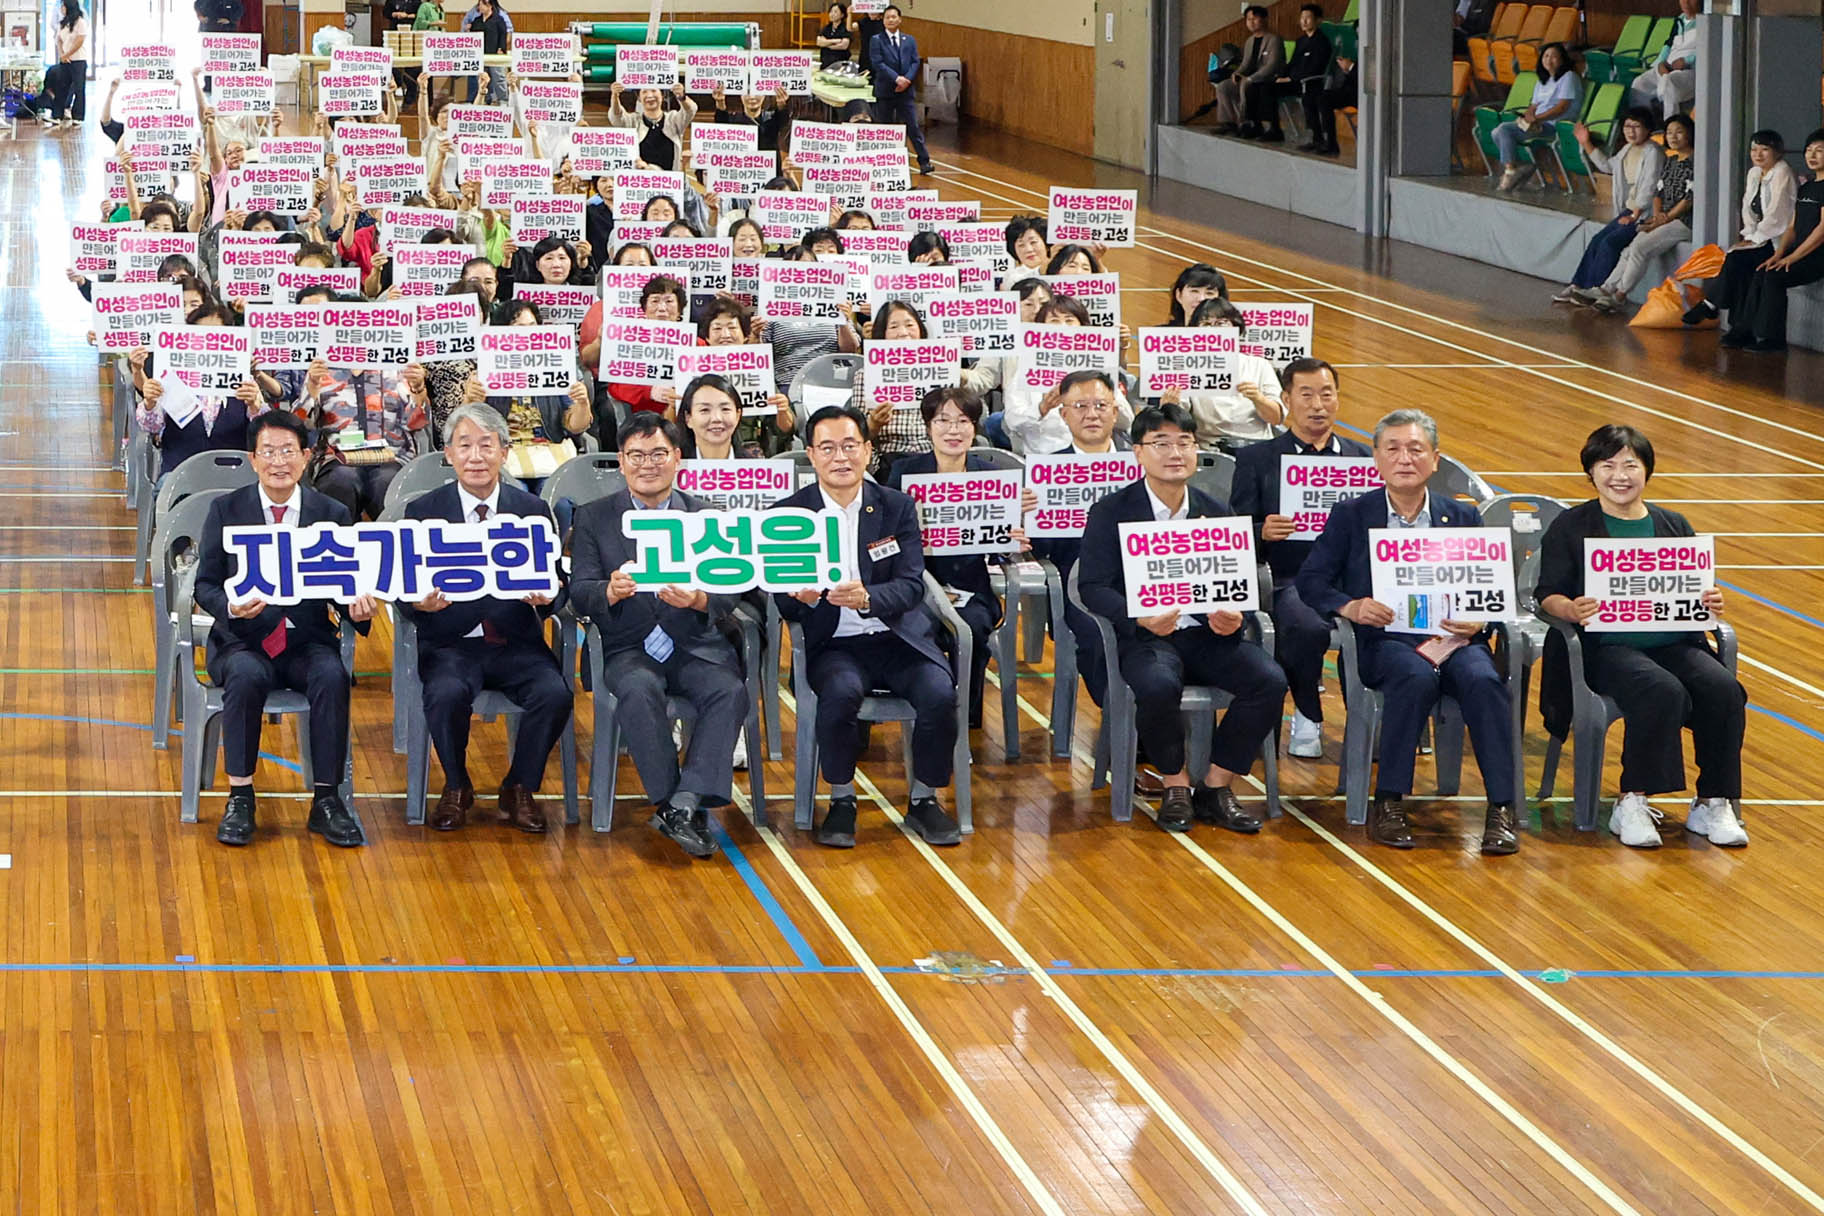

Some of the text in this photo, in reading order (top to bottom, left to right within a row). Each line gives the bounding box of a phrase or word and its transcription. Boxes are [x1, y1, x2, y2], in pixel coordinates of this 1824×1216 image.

[425, 36, 481, 48] 여성농업인이
[433, 49, 475, 59] 만들어가는
[618, 49, 676, 61] 여성농업인이
[427, 60, 479, 72] 성평등한 고성
[627, 62, 670, 71] 만들어가는
[620, 73, 674, 85] 성평등한 고성
[242, 168, 310, 182] 여성농업인이
[252, 184, 302, 195] 만들어가는
[245, 197, 307, 211] 성평등한 고성
[514, 199, 583, 213] 여성농업인이
[1052, 193, 1133, 211] 여성농업인이
[524, 215, 576, 226] 만들어가는
[1063, 211, 1123, 224] 만들어가는
[558, 228, 580, 242] 고성
[1054, 225, 1128, 242] 성평등한 고성
[763, 266, 844, 285] 여성농업인이
[774, 285, 835, 299] 만들어가는
[96, 292, 181, 313] 여성농업인이
[765, 300, 840, 318] 성평등한 고성
[109, 312, 173, 328] 만들어가는
[323, 309, 413, 327] 여성농업인이
[102, 330, 152, 348] 성평등한
[157, 331, 247, 352] 여성농업인이
[336, 329, 403, 343] 만들어가는
[481, 332, 571, 351] 여성농업인이
[1023, 330, 1114, 352] 여성농업인이
[1143, 334, 1235, 353] 여성농업인이
[170, 352, 237, 368] 만들어가는
[325, 345, 409, 364] 성평등한 고성
[495, 352, 562, 369] 만들어가는
[868, 345, 959, 365] 여성농업인이
[1036, 351, 1105, 367] 만들어가는
[1157, 355, 1225, 370] 만들어가는
[214, 372, 243, 390] 고성
[485, 370, 569, 390] 성평등한 고성
[882, 366, 949, 382] 만들어가는
[1148, 373, 1231, 391] 성평등한 고성
[873, 385, 925, 403] 성평등한
[675, 467, 788, 491] 여성농업인이
[1031, 460, 1141, 485] 여성농업인이
[906, 479, 1017, 504] 여성농업인이
[923, 503, 1005, 524] 만들어가는
[977, 524, 1012, 544] 고성
[1126, 527, 1249, 556] 여성농업인이
[631, 516, 840, 585] 고성을!
[1374, 537, 1506, 562] 여성농업인이
[232, 523, 552, 596] 지속가능한
[1147, 555, 1238, 579] 만들어가는
[1591, 547, 1714, 572] 여성농업인이
[1395, 565, 1493, 586] 만들어가는
[1609, 574, 1702, 595] 만들어가는
[1137, 578, 1248, 607] 성평등한 고성
[1464, 589, 1504, 612] 고성
[1596, 598, 1711, 623] 성평등한 고성
